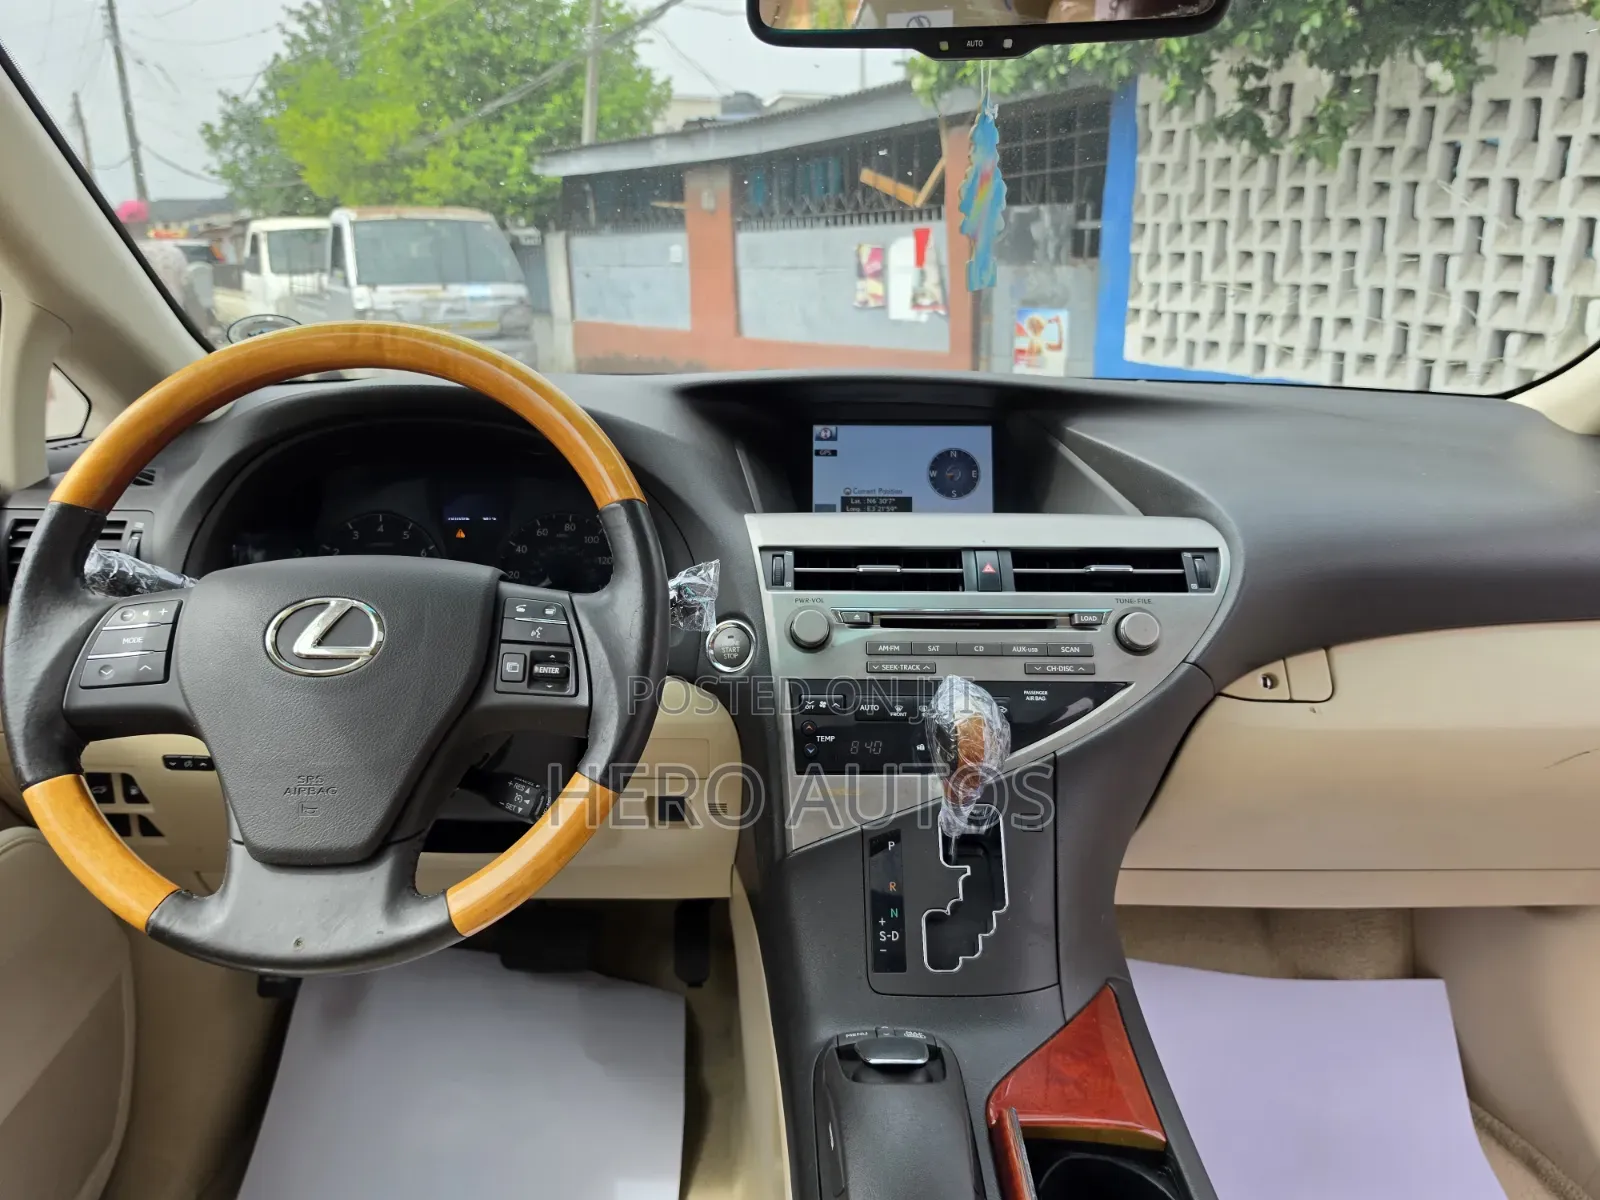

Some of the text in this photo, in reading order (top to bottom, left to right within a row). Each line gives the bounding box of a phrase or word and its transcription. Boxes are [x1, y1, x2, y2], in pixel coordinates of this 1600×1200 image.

[951, 490, 957, 498] S
[377, 524, 384, 533] 4
[564, 523, 576, 532] 80
[352, 531, 360, 540] 3
[402, 531, 410, 540] 5
[536, 528, 549, 537] 60
[584, 535, 600, 544] 100
[420, 548, 428, 557] 6
[515, 545, 528, 554] 40
[508, 570, 520, 579] 20
[122, 636, 144, 645] MODE
[539, 666, 560, 674] ENTER
[297, 775, 324, 785] SRS
[283, 786, 338, 797] AIRBAG
[505, 803, 516, 811] SET
[888, 841, 895, 851] P
[889, 881, 897, 891] R
[890, 908, 898, 918] N
[879, 930, 899, 941] S-D
